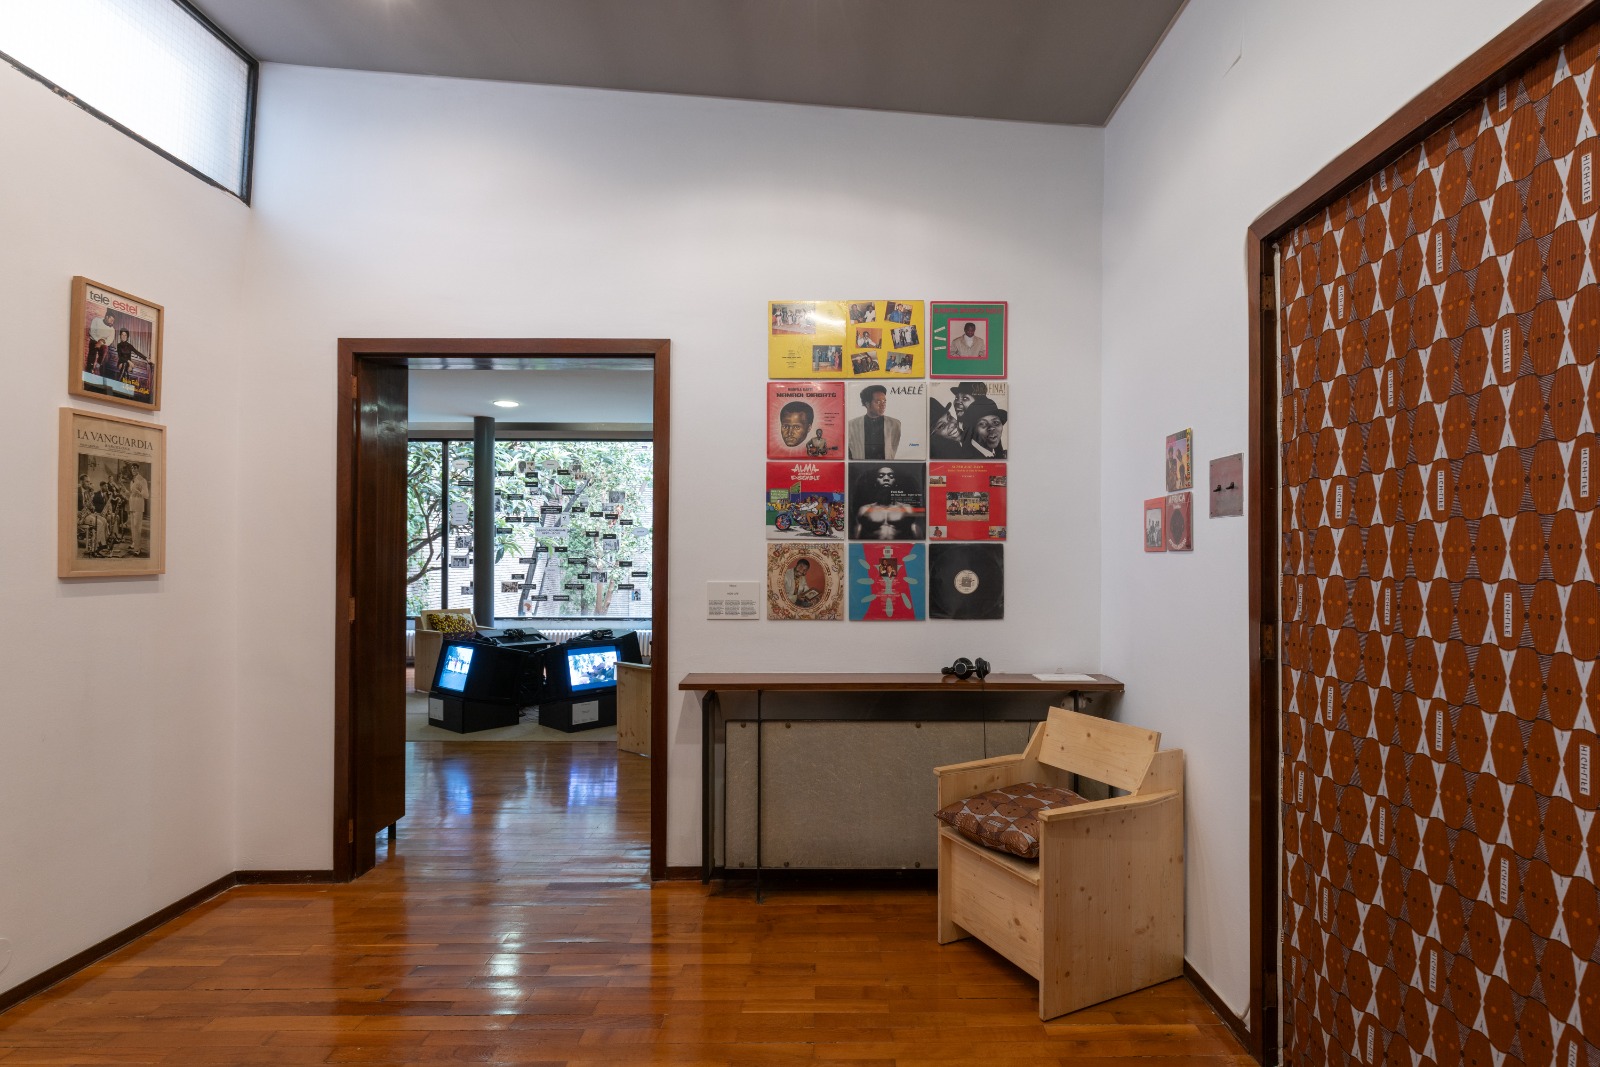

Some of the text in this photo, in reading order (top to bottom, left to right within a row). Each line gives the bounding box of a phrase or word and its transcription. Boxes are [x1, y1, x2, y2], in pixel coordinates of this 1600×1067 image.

[89, 290, 138, 315] tele estel
[890, 383, 924, 395] MAELÉ
[77, 429, 153, 451] LA VANGUARDIA
[790, 463, 820, 473] ALMA
